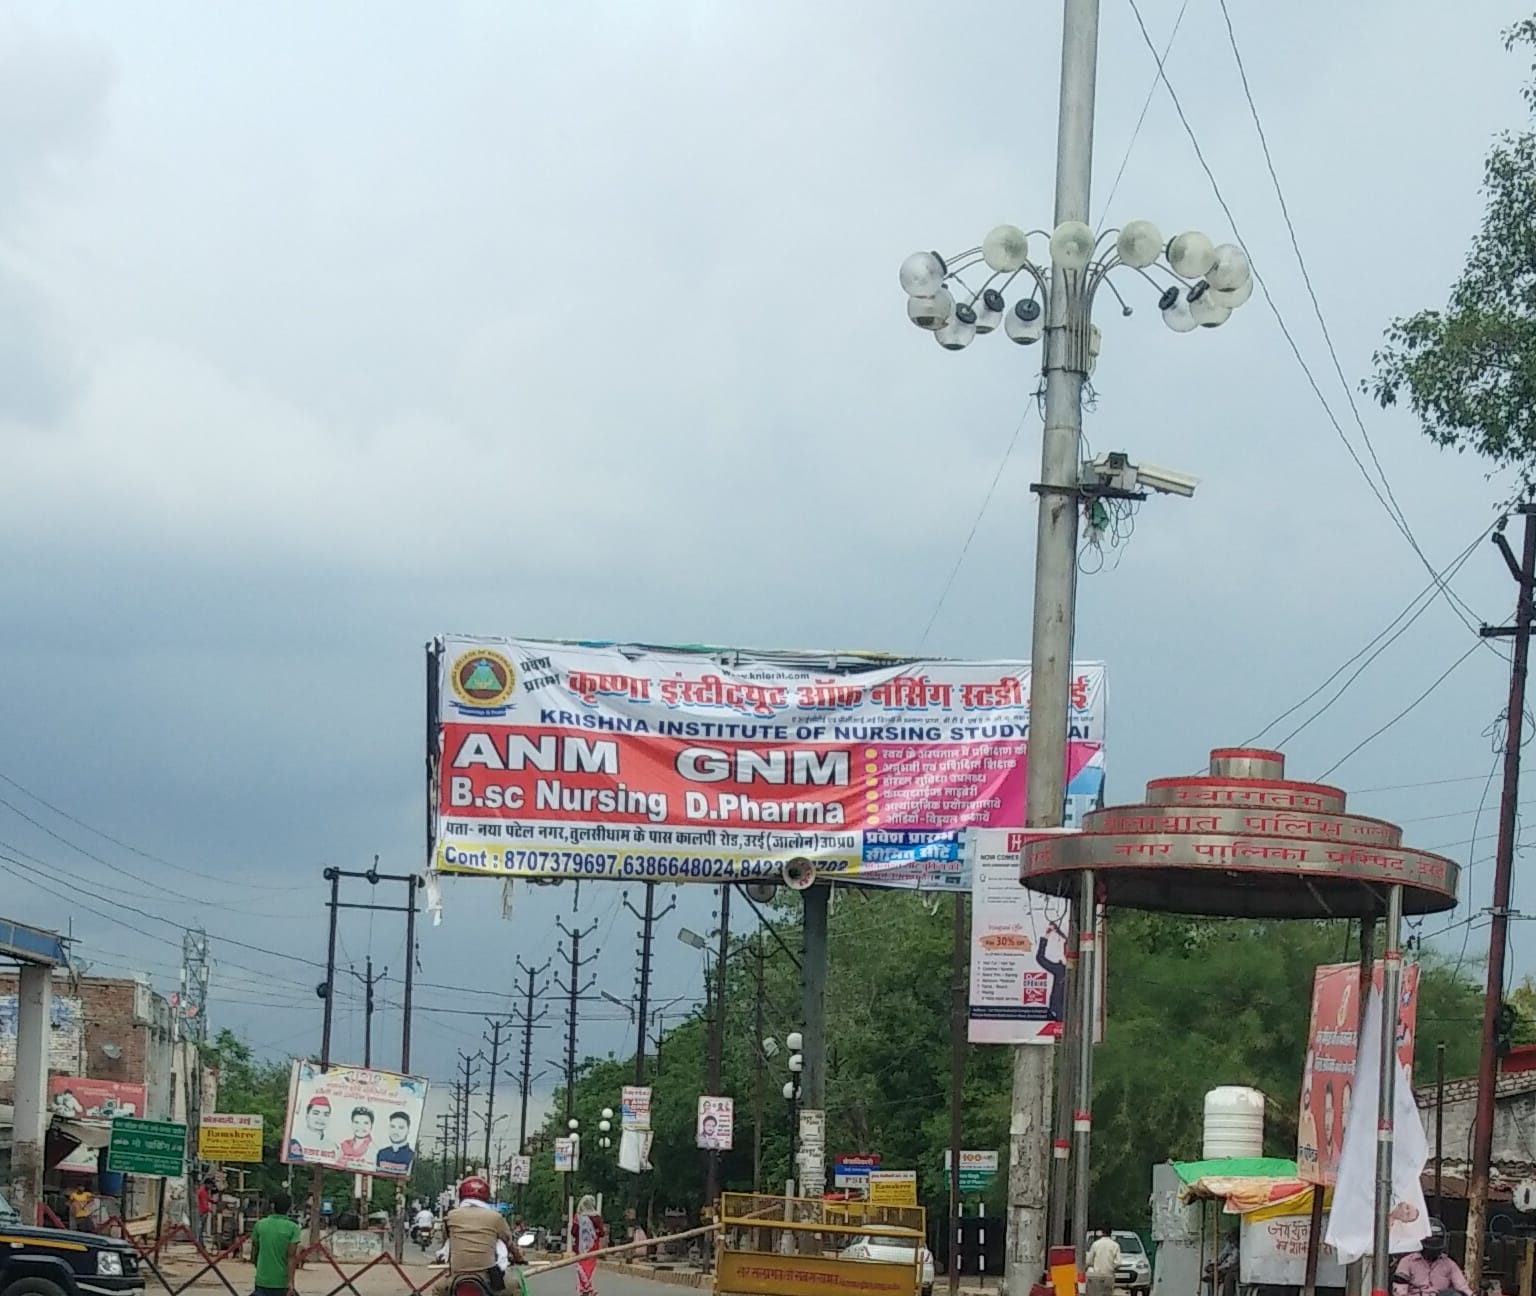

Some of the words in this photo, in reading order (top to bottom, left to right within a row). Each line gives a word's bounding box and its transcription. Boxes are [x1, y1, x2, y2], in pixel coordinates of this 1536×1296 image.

[567, 670, 652, 708] कृष्णा
[796, 678, 865, 711] ऑफ
[871, 675, 953, 712] नर्सिंग
[540, 708, 650, 734] KRISHNA
[658, 720, 789, 740] INSTITUTE
[796, 725, 826, 741] OF
[834, 725, 942, 741] NURSING
[950, 724, 1029, 741] STUDY
[452, 731, 621, 776] ANM
[675, 745, 851, 787] GNM
[450, 776, 525, 810] B.sc
[536, 779, 668, 823] Nursing
[685, 790, 846, 825] D.Pharma
[478, 824, 502, 838] नया
[505, 821, 535, 839] पटेल
[633, 826, 646, 843] के
[649, 830, 672, 844] पास
[676, 828, 717, 846] कालपी
[444, 846, 487, 868] Cont
[1113, 843, 1174, 858] नगर
[1192, 841, 1310, 862] पालिका
[996, 936, 1015, 946] 30%
